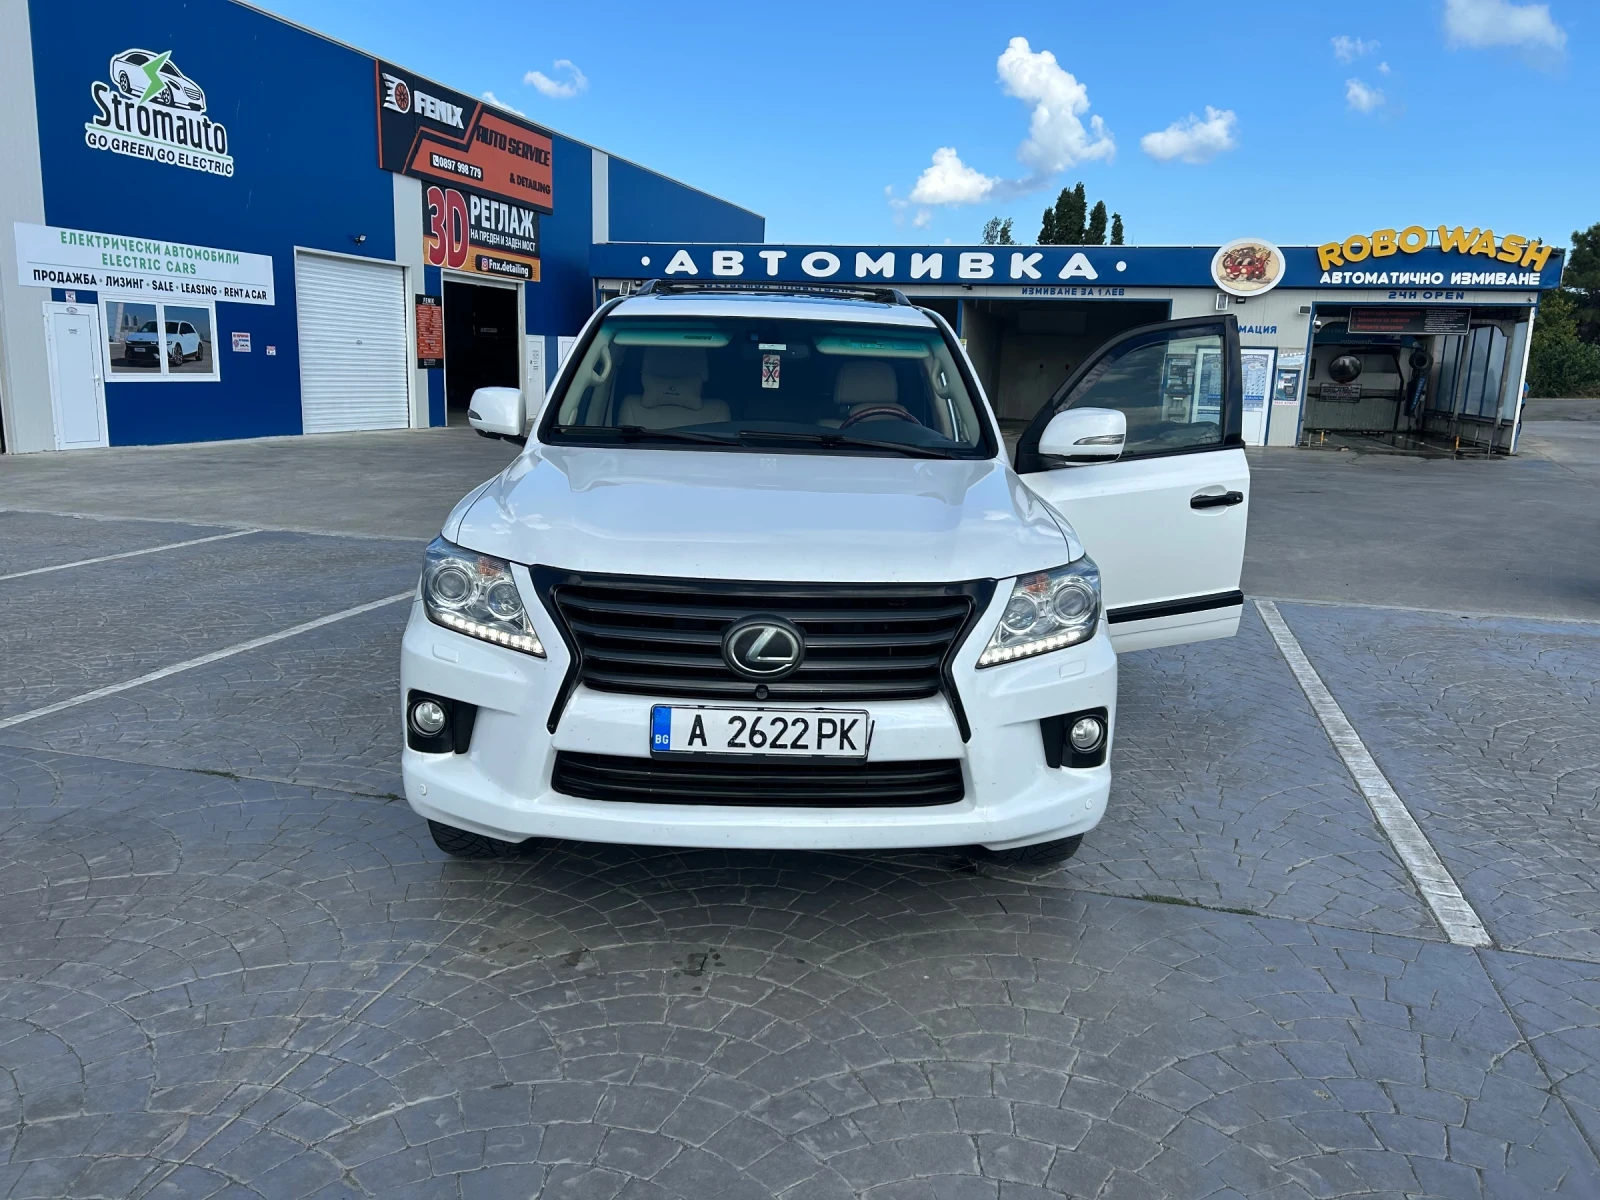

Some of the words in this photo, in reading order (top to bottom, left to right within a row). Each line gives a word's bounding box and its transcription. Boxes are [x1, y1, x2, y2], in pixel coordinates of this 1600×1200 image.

[94, 84, 226, 154] Stromauto
[413, 90, 464, 129] FENIX
[88, 133, 108, 147] GO
[111, 138, 154, 158] GREEN
[157, 148, 175, 162] GO
[178, 153, 233, 175] ELECTRIC
[476, 125, 507, 152] AUTO
[507, 137, 550, 167] SERVICE
[439, 156, 456, 171] 0897
[509, 173, 516, 184] &
[516, 175, 551, 195] DETAILING
[427, 186, 469, 269] 3D
[470, 195, 534, 239] РЕГЛАЖ
[60, 231, 161, 255] ЕЛЕКТРИЧЕСКИ
[164, 244, 239, 265] АВТОМОБИЛИ
[470, 228, 478, 240] НА
[479, 230, 501, 245] ПРЕДЕН
[505, 236, 522, 250] ЗАДЕН
[522, 239, 536, 252] МОСТ
[1317, 225, 1429, 271] ROBO
[1437, 224, 1553, 272] WASH
[101, 253, 161, 271] ELECTRIC
[166, 260, 197, 275] CARS
[488, 258, 529, 277] Fnx.detailing
[664, 249, 1099, 280] АВТОМИВКА
[1320, 271, 1444, 285] АВТОМАТИЧНО
[1450, 272, 1541, 286] ИЗМИВАНЕ
[33, 269, 97, 285] ПРОДАЖБА
[105, 275, 144, 289] ЛИЗИНГ
[152, 280, 174, 292] SALE
[181, 282, 217, 296] LEASING
[224, 286, 243, 299] RENT
[244, 289, 251, 299] A
[251, 290, 267, 300] CAR
[1022, 287, 1077, 296] ИЗМИВАНЕ
[1080, 287, 1094, 296] ЗА
[1104, 288, 1125, 296] ЛЕВ
[1388, 291, 1417, 300] 24H
[1422, 291, 1465, 300] OPEN
[1238, 325, 1277, 335] МАЦИЯ
[655, 734, 669, 744] BG
[687, 714, 708, 747] A
[727, 715, 809, 749] 2622
[816, 717, 859, 750] PK
